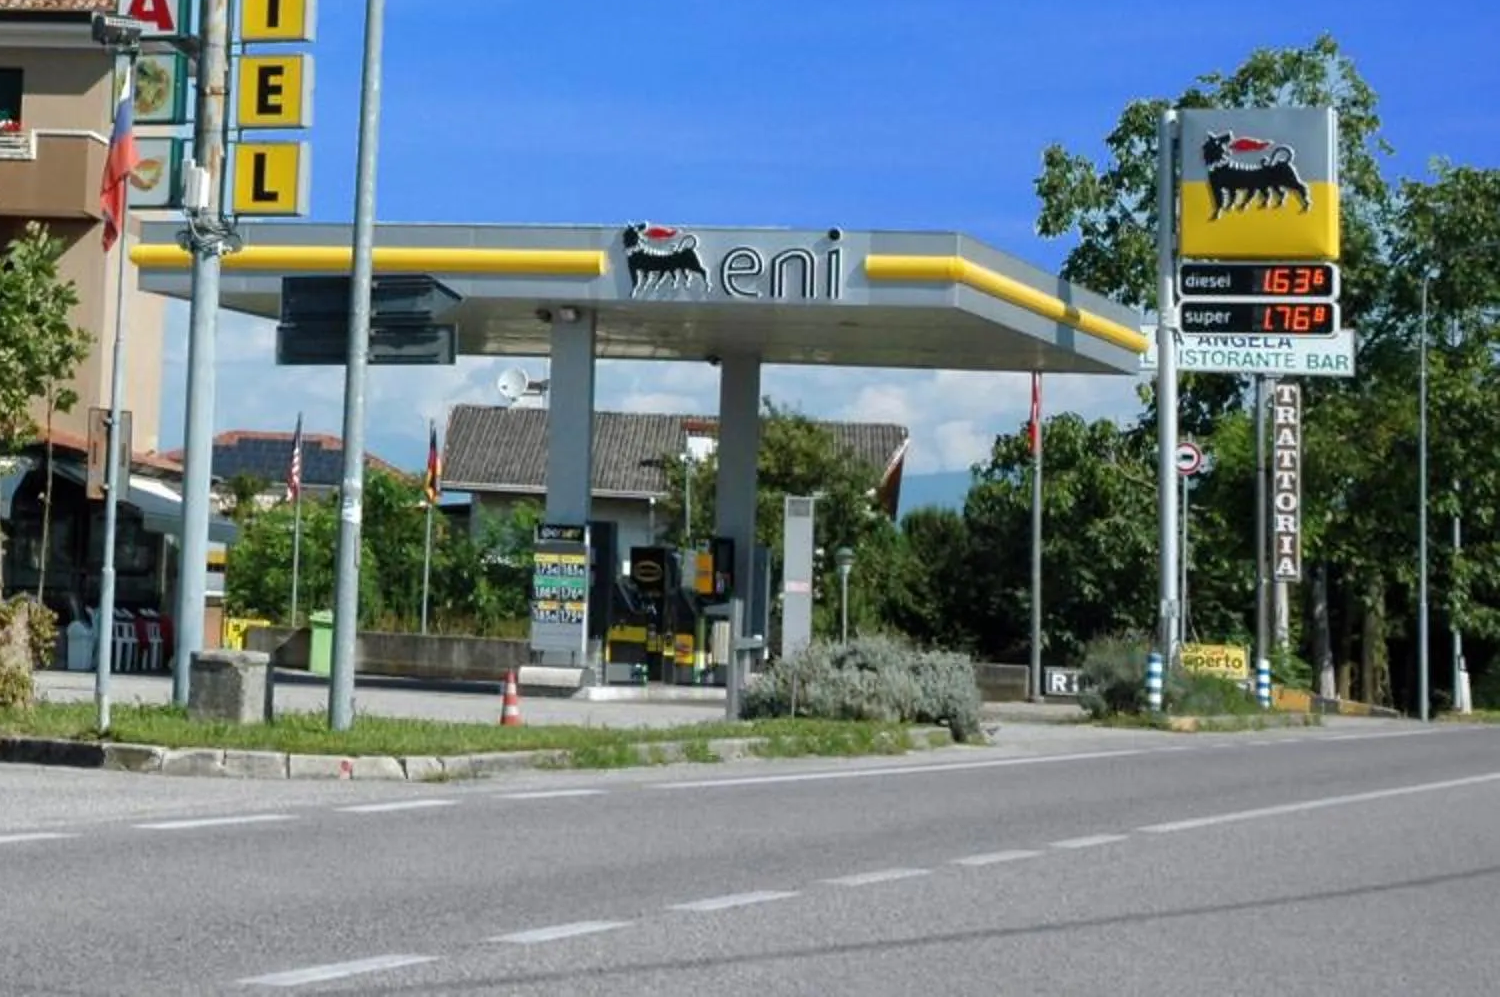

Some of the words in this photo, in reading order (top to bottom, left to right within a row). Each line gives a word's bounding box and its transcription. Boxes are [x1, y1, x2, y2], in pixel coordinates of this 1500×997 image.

[720, 228, 843, 299] eni
[1185, 274, 1231, 288] diesel
[1185, 310, 1231, 325] super
[1178, 349, 1296, 369] ISTORANTE
[1307, 353, 1349, 371] BAR
[1275, 384, 1298, 576] TRATTORIA
